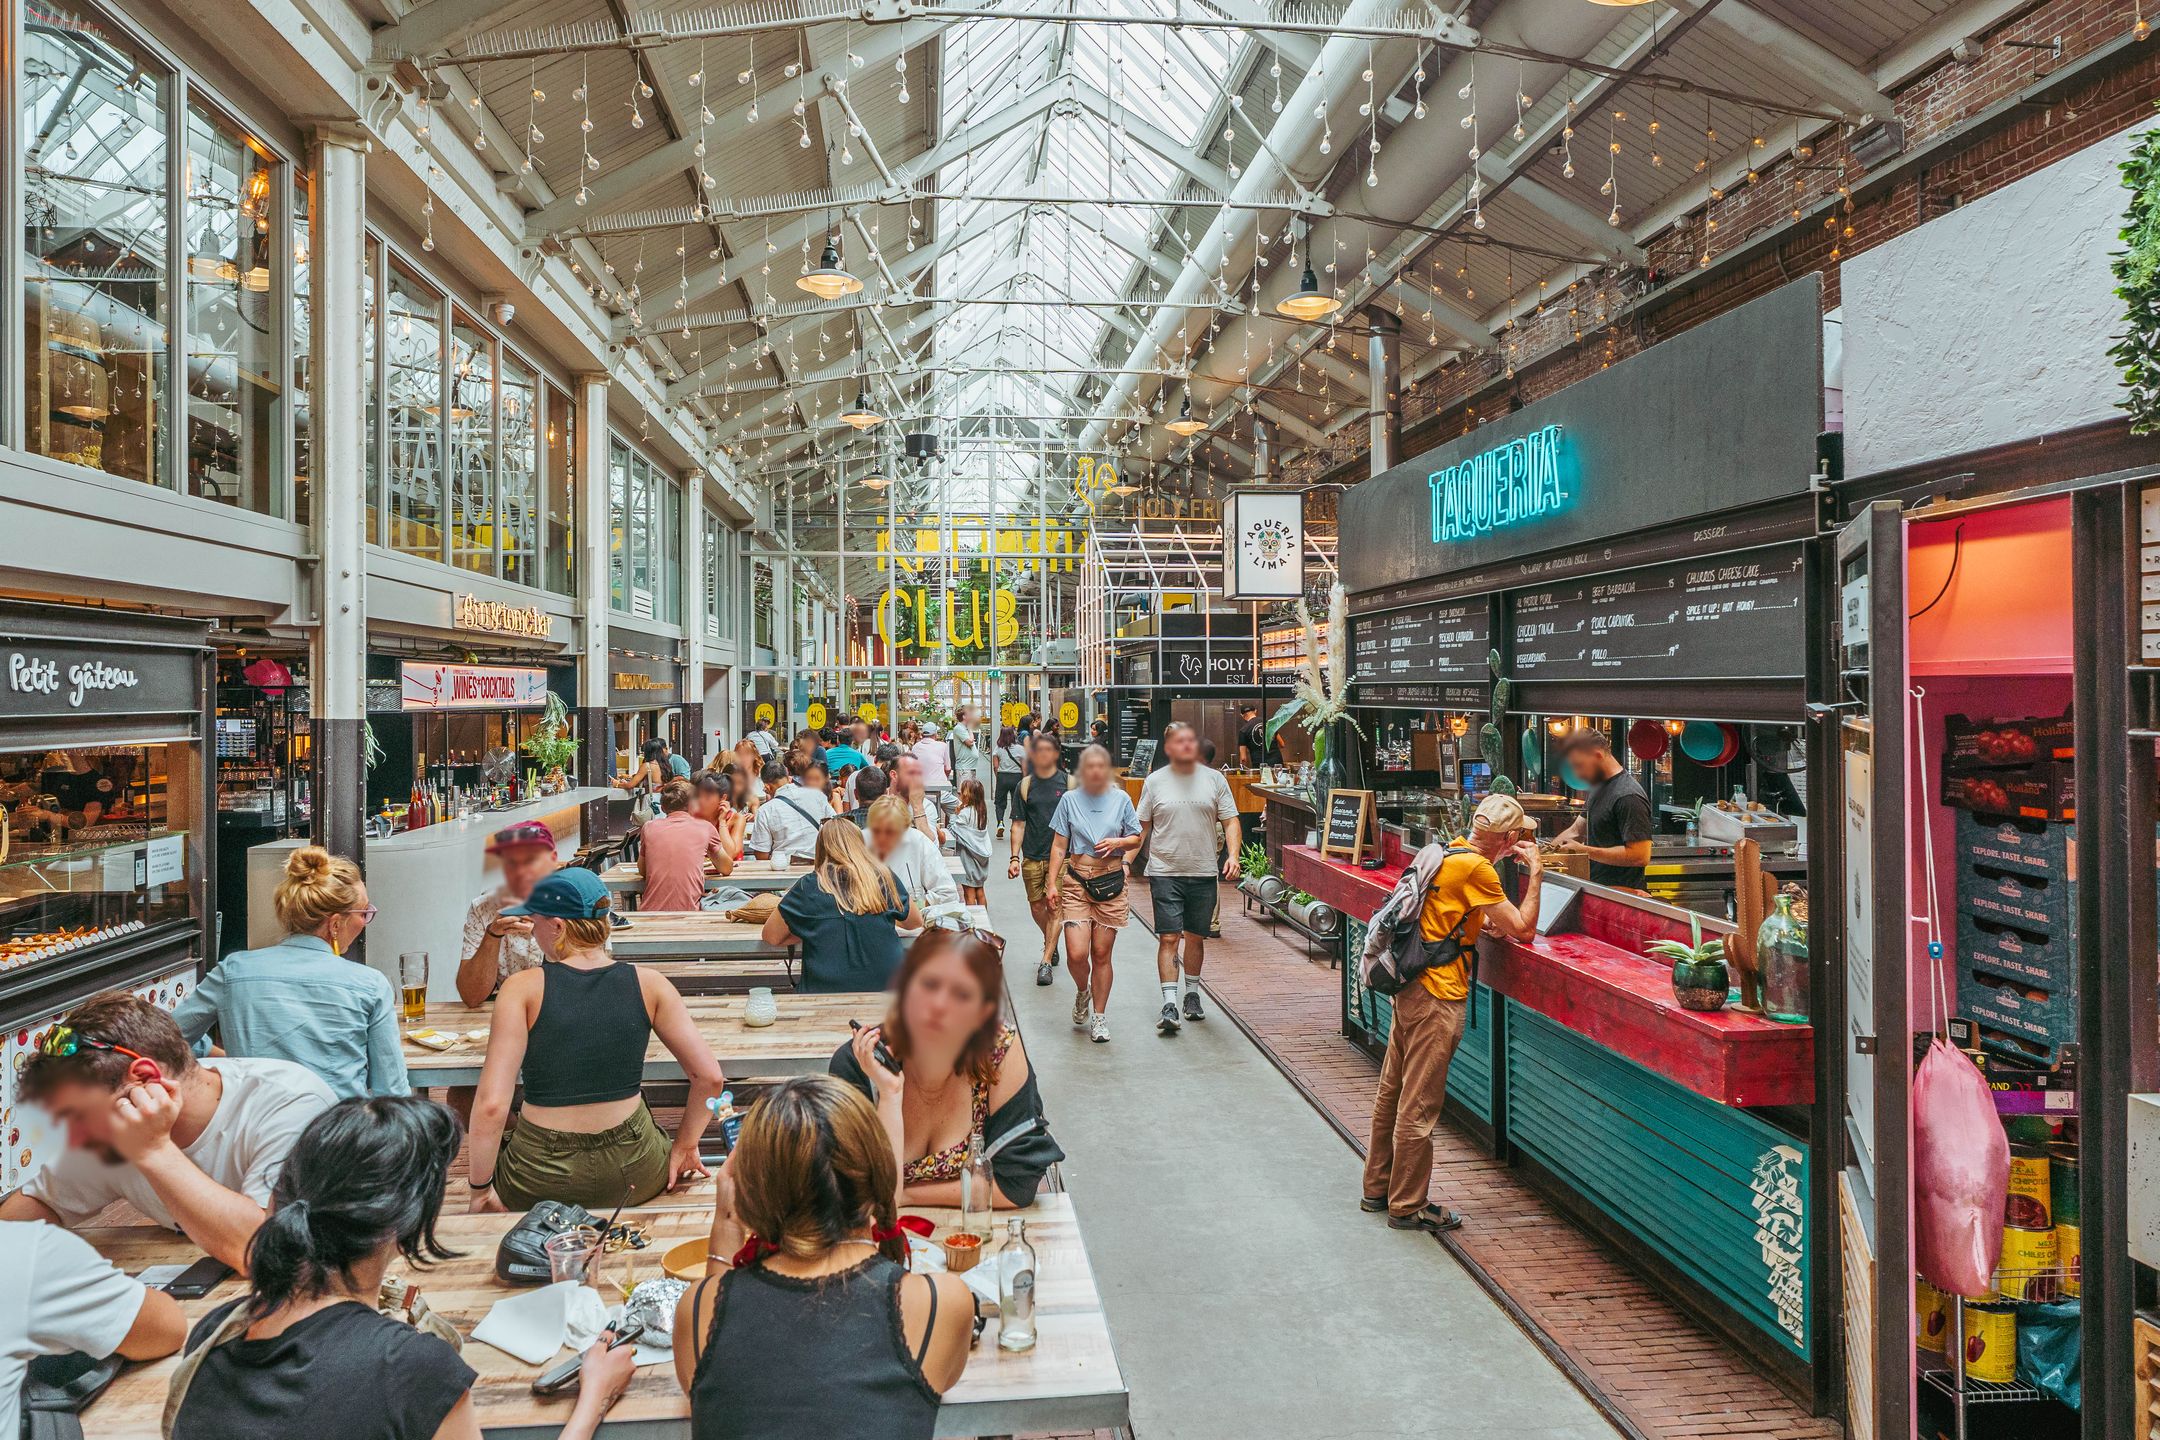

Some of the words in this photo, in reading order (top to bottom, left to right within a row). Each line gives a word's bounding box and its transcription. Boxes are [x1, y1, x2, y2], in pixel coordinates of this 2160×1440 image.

[1428, 424, 1561, 543] TAQUERIA
[1132, 497, 1184, 518] HOLY
[1190, 498, 1222, 518] FRI
[1245, 520, 1295, 549] TAQUERIA
[1693, 526, 1727, 542] DESSERT
[1253, 557, 1287, 570] LIMA
[1686, 569, 1715, 584] CHURROS
[1591, 586, 1605, 598] BEEF
[877, 588, 1020, 650] CLUB
[1686, 605, 1701, 616] SPICE
[1591, 616, 1606, 629] PORK
[1209, 658, 1245, 671] HOLY
[9, 653, 59, 694] Petit
[69, 661, 138, 707] gâteau
[1227, 675, 1249, 684] EST.
[1972, 846, 2001, 858] EXPLORE.
[2001, 851, 2023, 862] TASTE.
[2023, 855, 2049, 868] SHARE.
[1973, 898, 2002, 911] EXPLORE.
[2002, 904, 2023, 917] TASTE.
[2025, 910, 2050, 923] SHARE.
[1973, 951, 2002, 966] EXPLORE.
[2003, 959, 2025, 972] TASTE.
[2025, 965, 2051, 979] SHARE.
[1971, 1005, 2001, 1021] EXPLORE.
[2001, 1015, 2023, 1028] TASTE.
[2023, 1021, 2050, 1037] SHARE.
